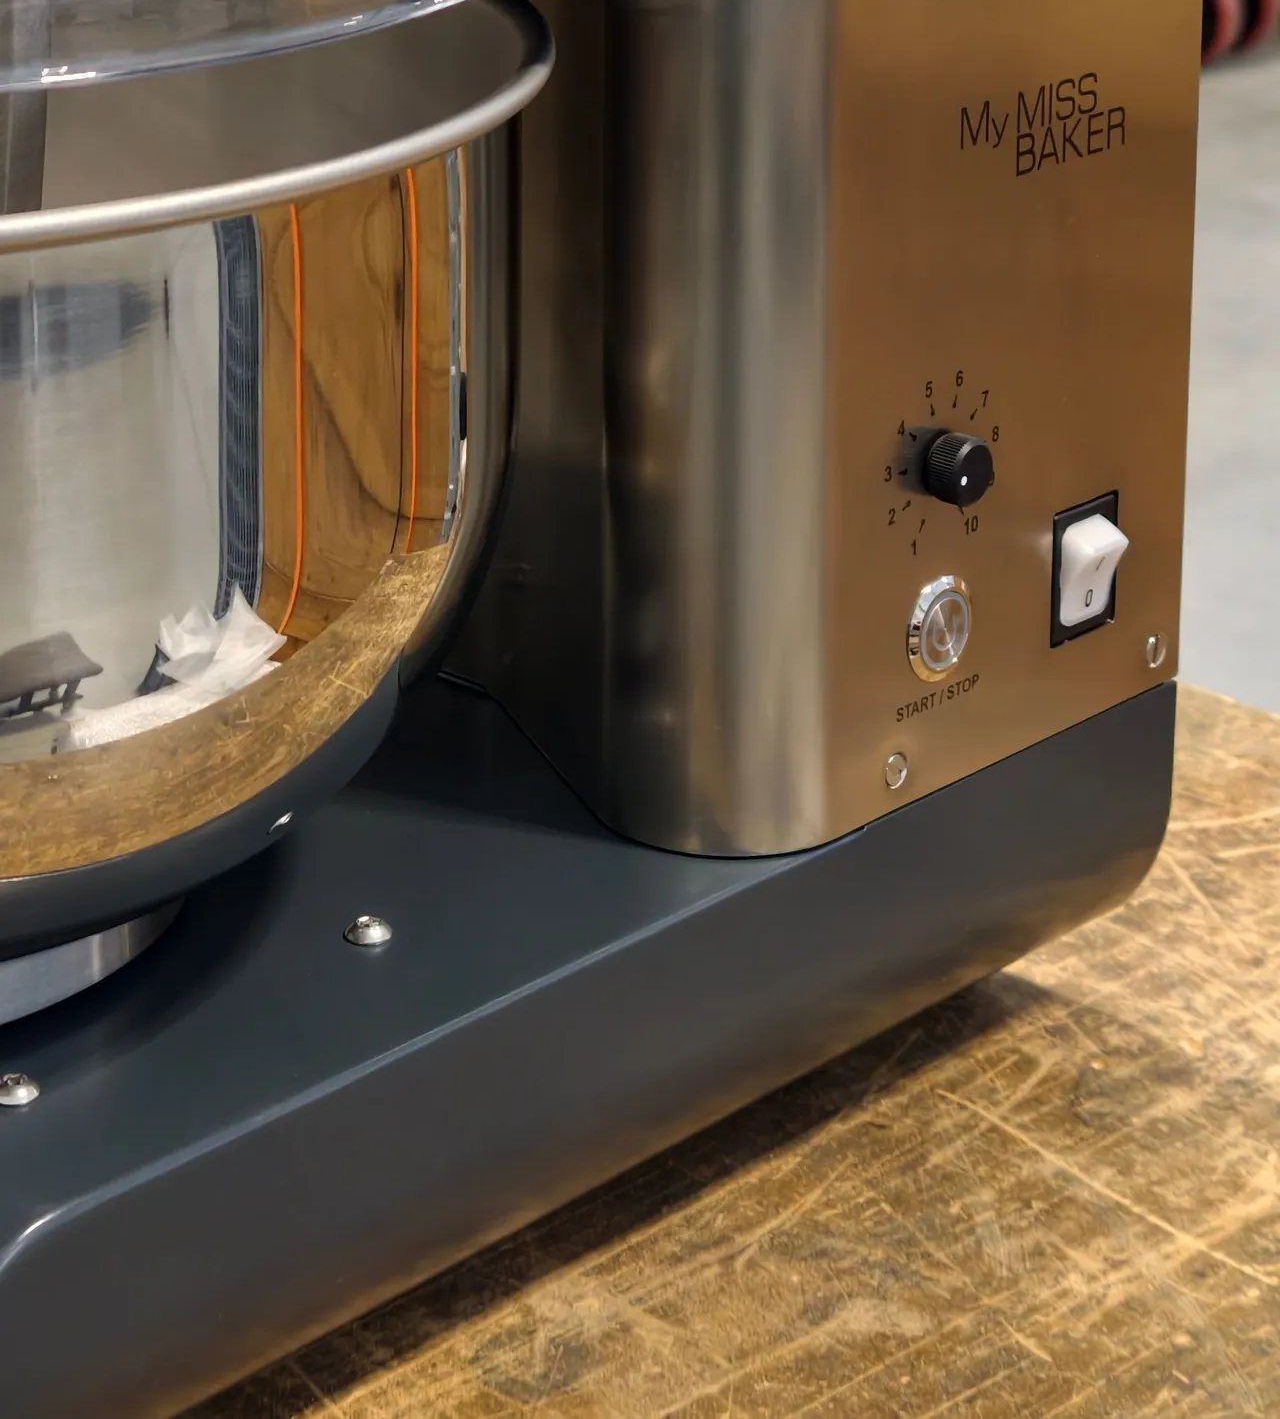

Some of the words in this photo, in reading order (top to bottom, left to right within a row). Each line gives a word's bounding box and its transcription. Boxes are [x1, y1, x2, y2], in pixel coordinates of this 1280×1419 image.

[960, 100, 1009, 150] My
[1016, 72, 1098, 134] MISS
[1016, 106, 1126, 177] BAKER
[955, 370, 963, 387] 6
[925, 381, 933, 398] 5
[981, 390, 989, 407] 7
[897, 420, 905, 436] 4
[991, 426, 1000, 442] 8
[884, 466, 892, 482] 3
[888, 508, 896, 526] 2
[963, 516, 979, 535] 10
[911, 539, 917, 556] 1
[896, 692, 937, 723] START
[946, 674, 980, 701] STOP
